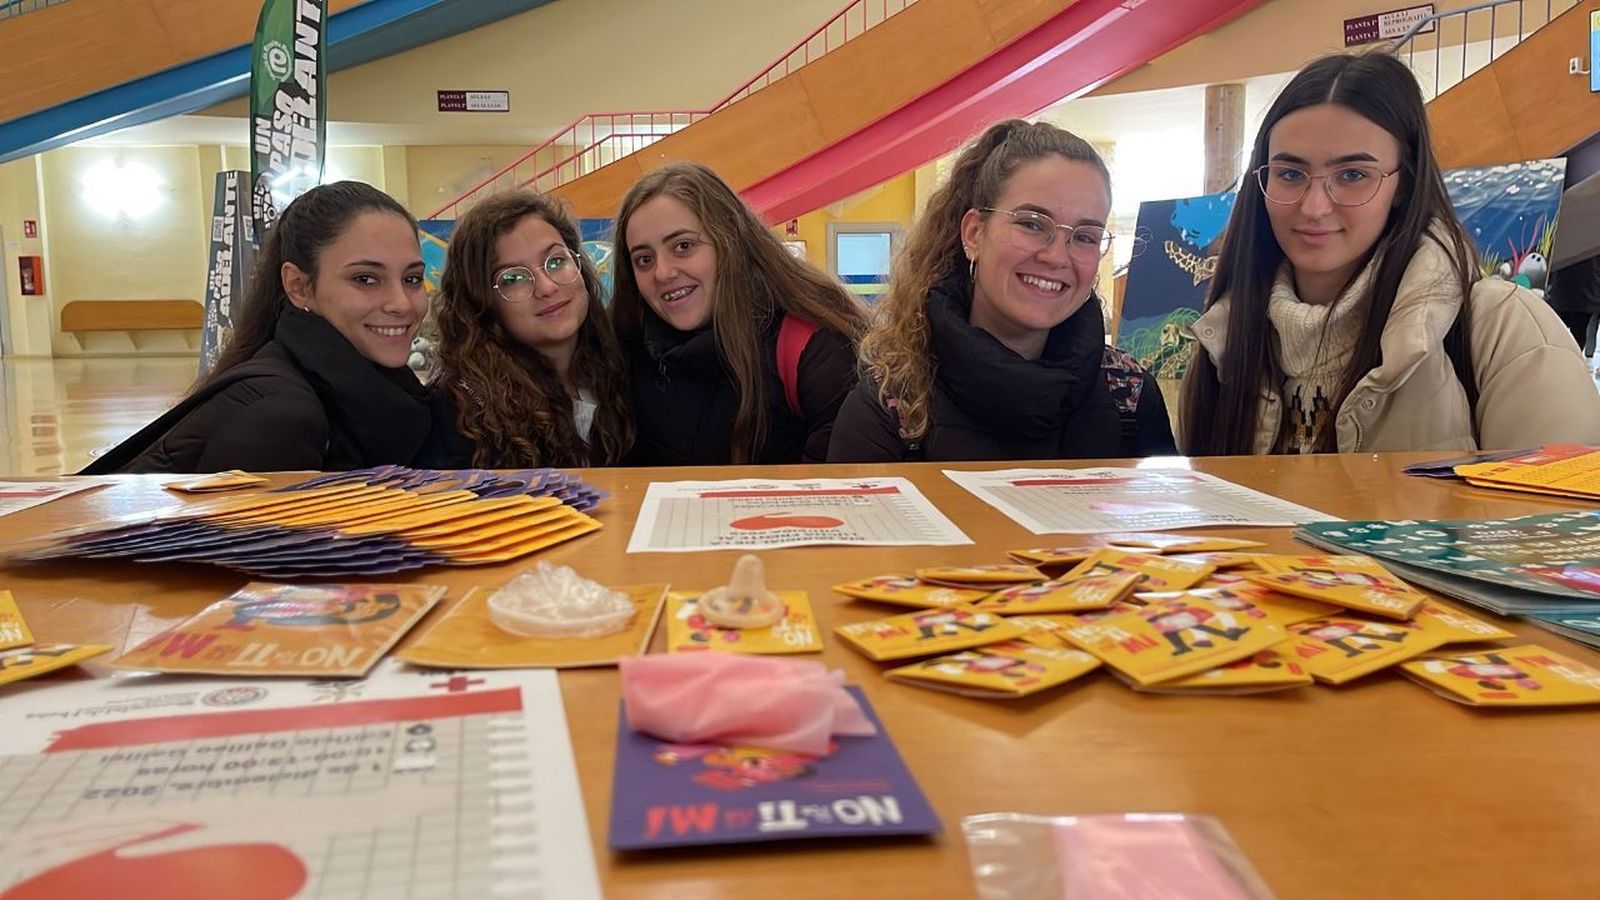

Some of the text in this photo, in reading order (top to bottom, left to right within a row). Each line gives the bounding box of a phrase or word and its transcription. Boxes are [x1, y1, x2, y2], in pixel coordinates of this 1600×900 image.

[1346, 21, 1371, 31] PLANTA
[1347, 33, 1371, 43] PLANTA
[254, 117, 271, 155] UN
[269, 89, 295, 172] PASO
[219, 170, 238, 318] ADELANTE
[300, 643, 363, 668] NO
[832, 796, 903, 827] NO
